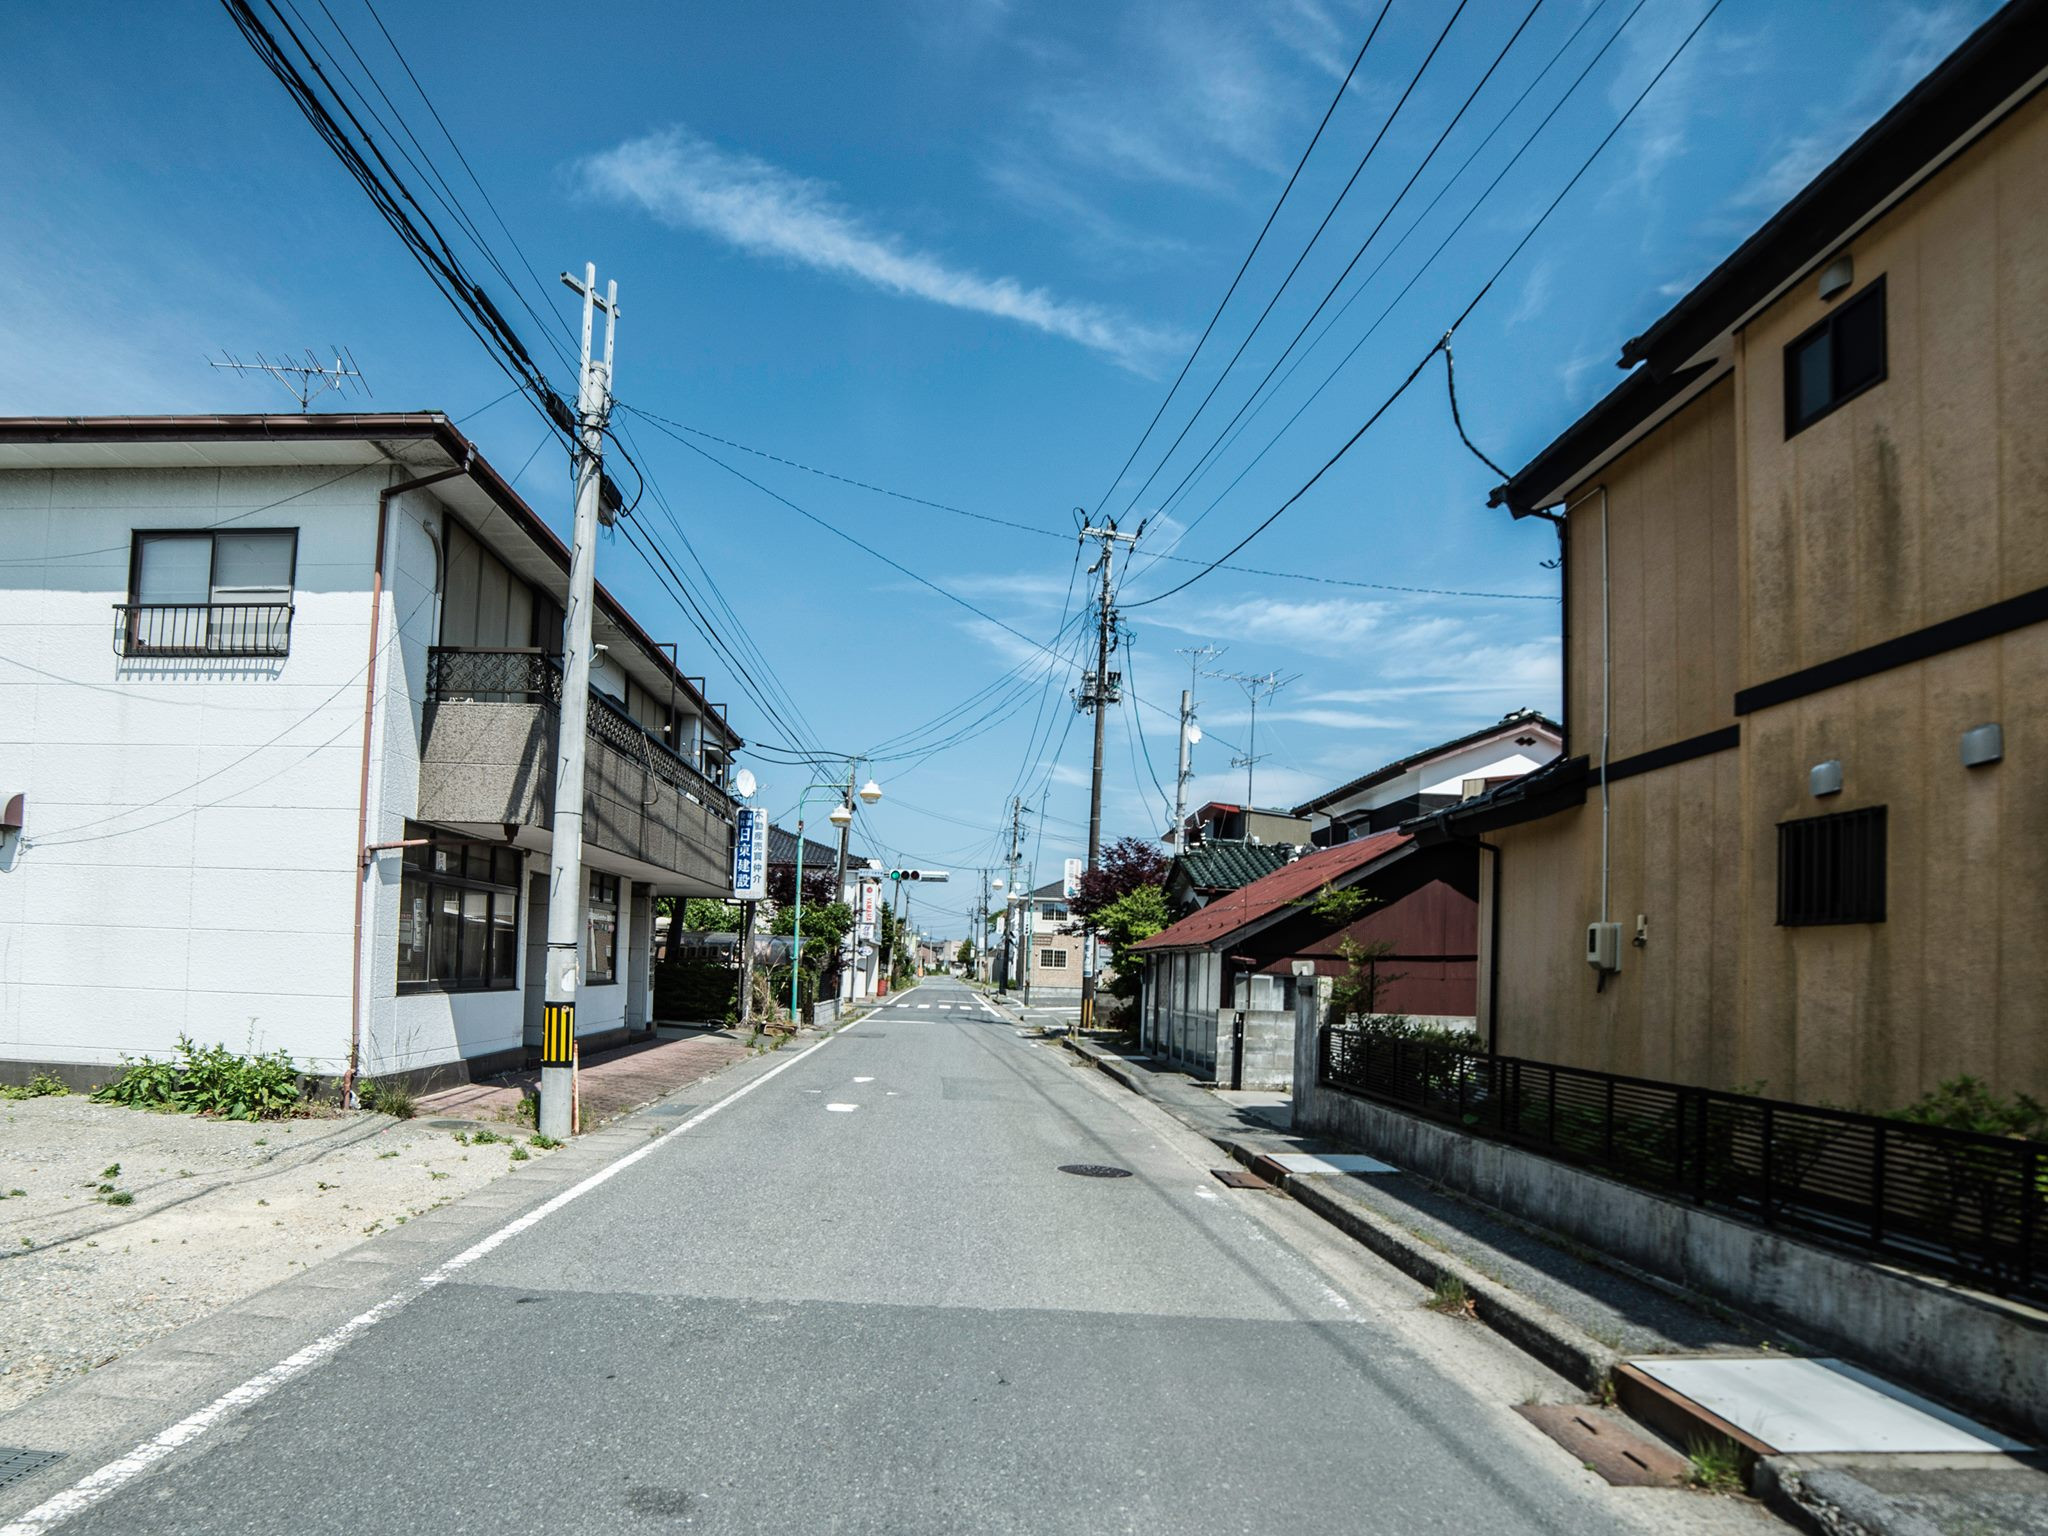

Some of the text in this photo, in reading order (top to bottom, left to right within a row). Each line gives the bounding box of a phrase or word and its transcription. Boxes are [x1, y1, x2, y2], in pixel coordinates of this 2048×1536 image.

[737, 827, 751, 888] 日東建設
[752, 810, 764, 884] 不動産売買仲介
